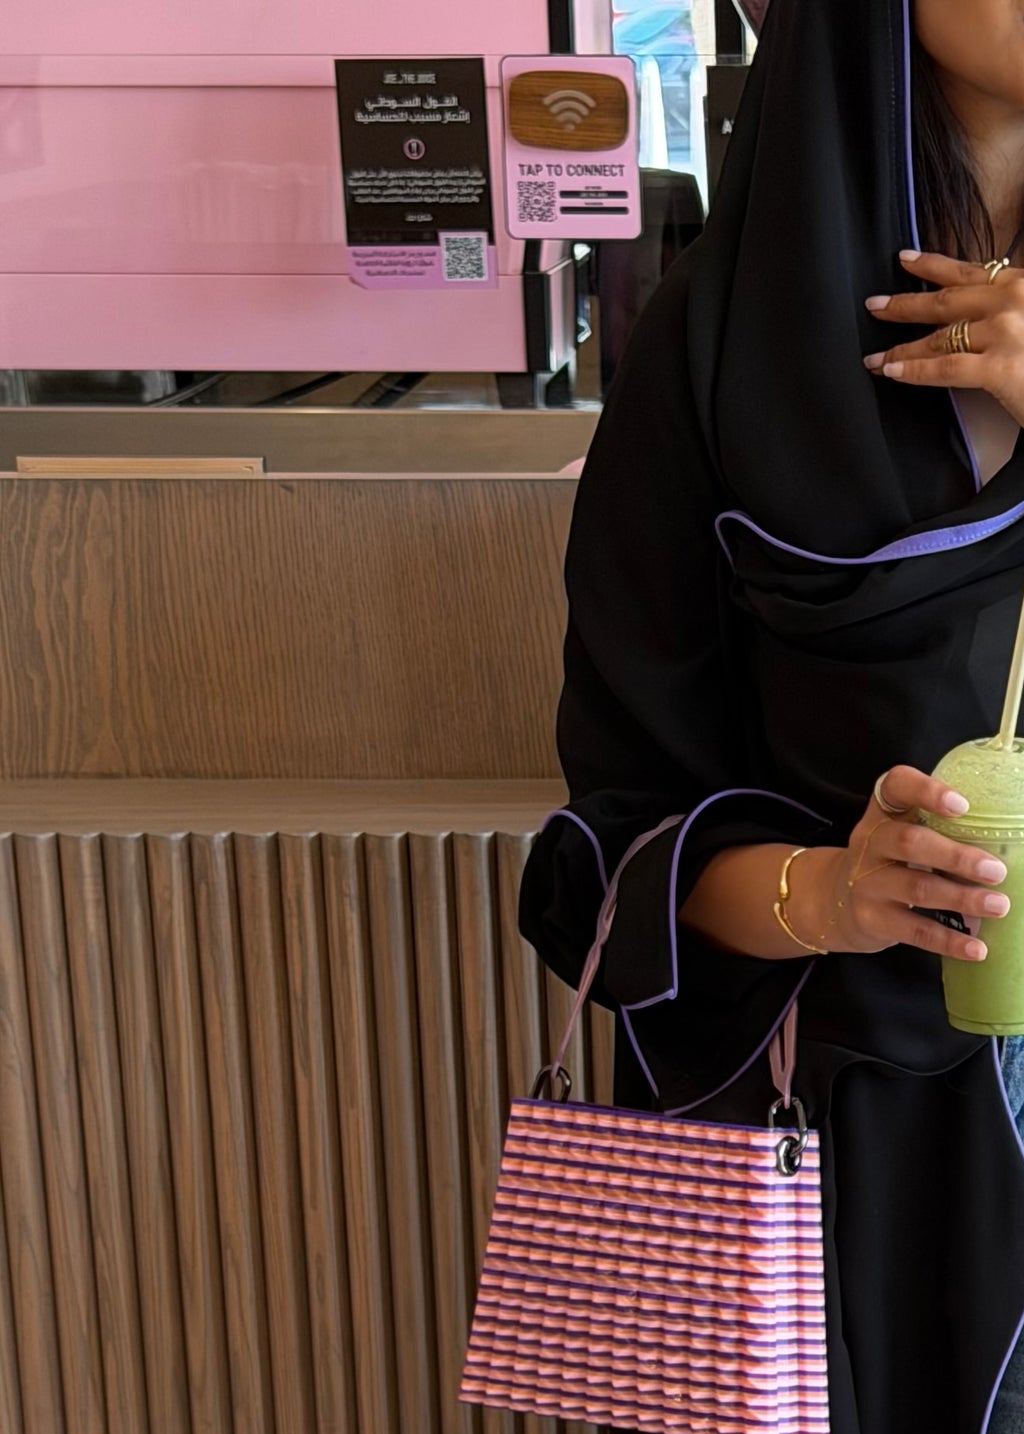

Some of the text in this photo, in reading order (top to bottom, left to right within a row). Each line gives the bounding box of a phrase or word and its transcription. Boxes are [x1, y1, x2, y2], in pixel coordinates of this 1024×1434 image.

[518, 164, 625, 177] TAP TO CONNECT
